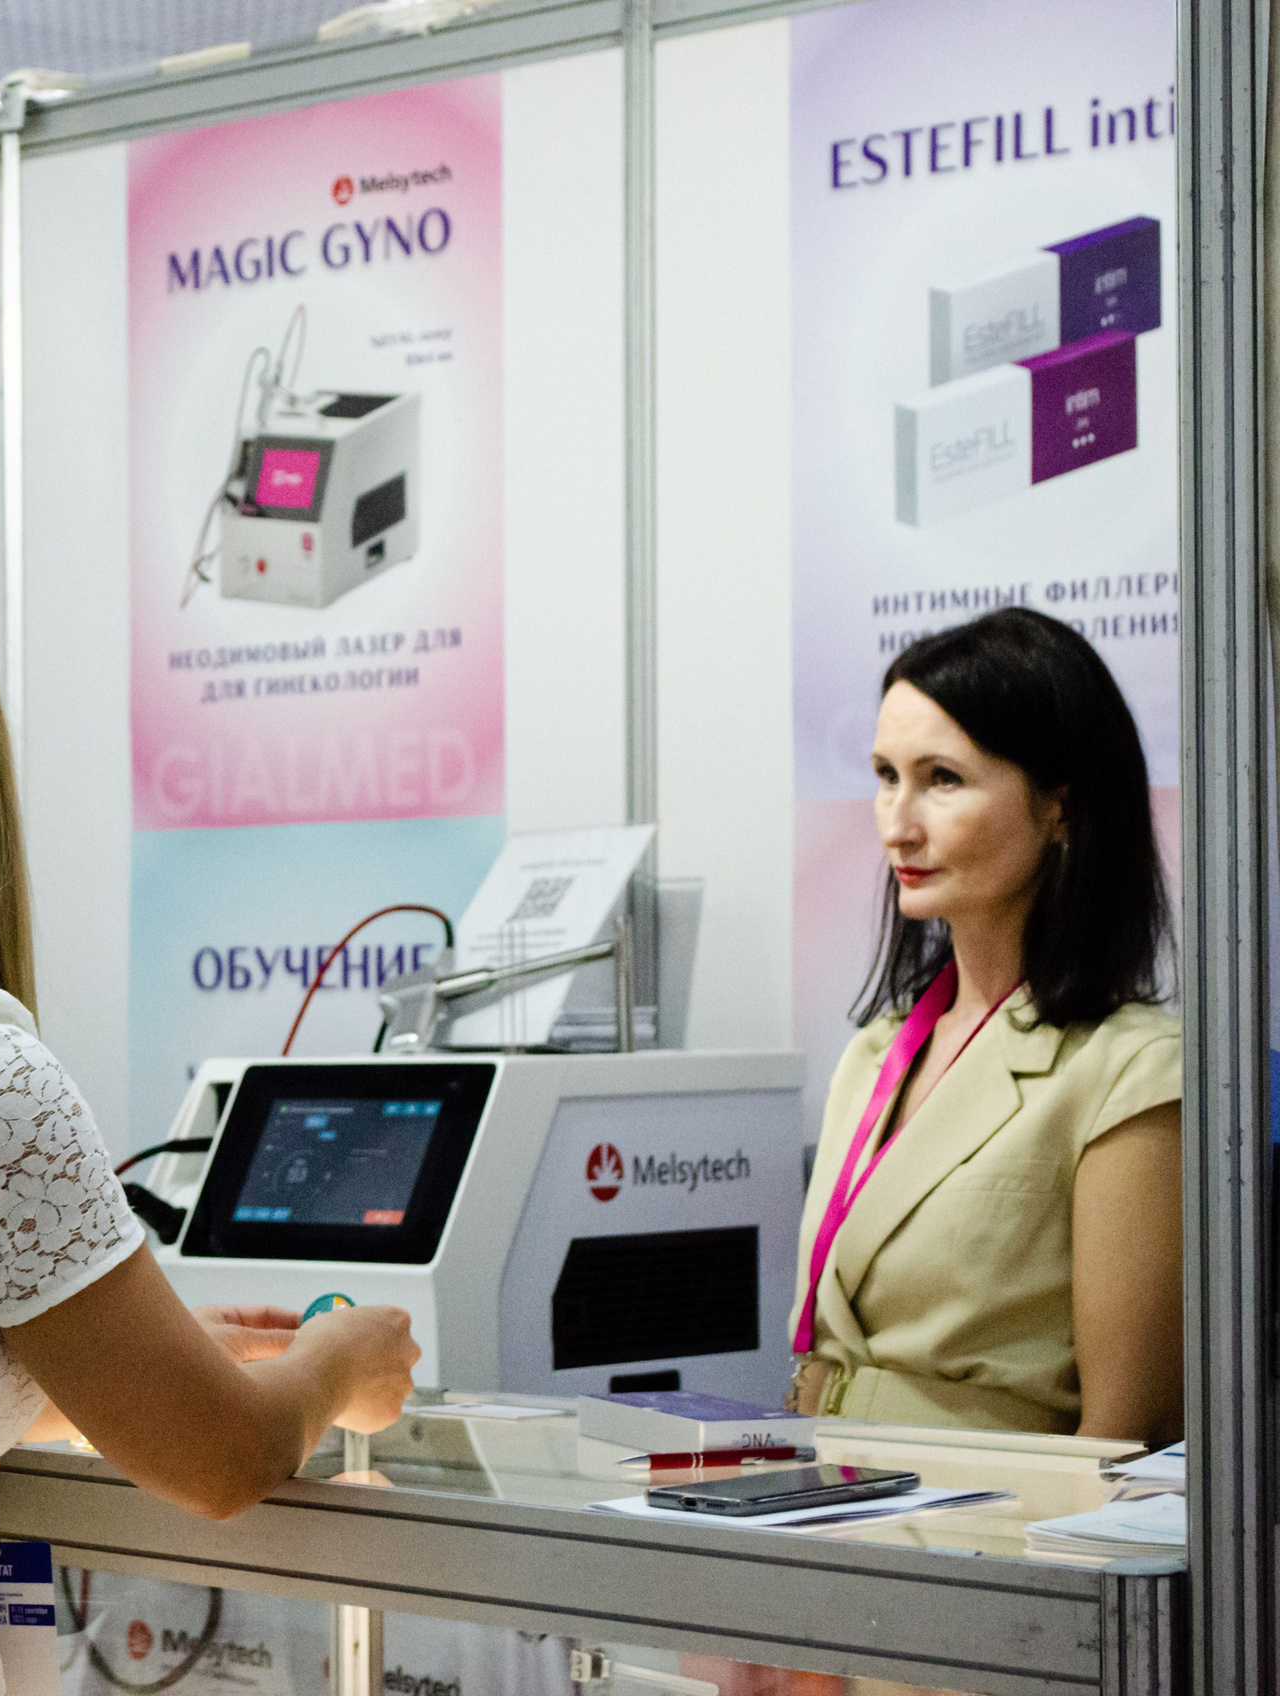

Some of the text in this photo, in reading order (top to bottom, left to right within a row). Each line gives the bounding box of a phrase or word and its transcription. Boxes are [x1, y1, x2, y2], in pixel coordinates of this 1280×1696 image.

[831, 106, 1071, 190] ESTEFILL
[166, 206, 452, 295] MAGIC GYNO
[872, 581, 1033, 617] ИНТИМНЫЕ
[167, 626, 462, 671] НЕОДИМОВЫЙ ЛАЗЕР ДЛЯ
[200, 666, 420, 704] ДЛЯ ГИНЕКОЛОГИИ
[155, 728, 474, 820] GIALMED
[192, 943, 435, 992] ОБУЧЕНИЕ
[632, 1149, 752, 1193] Melsytech
